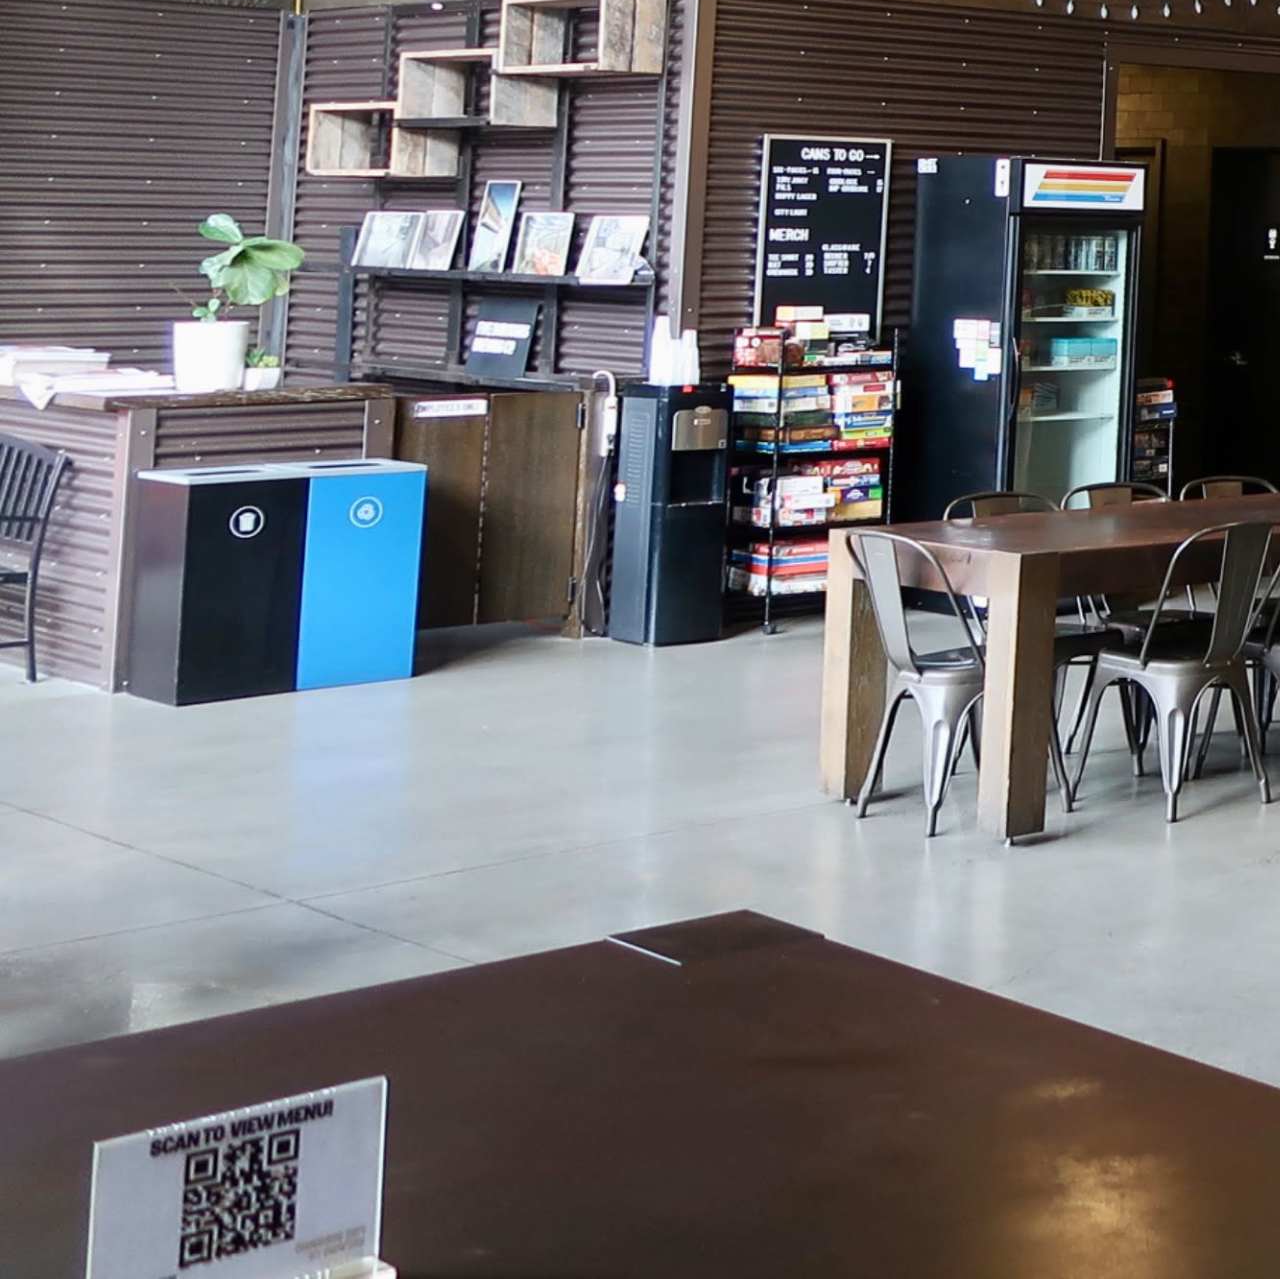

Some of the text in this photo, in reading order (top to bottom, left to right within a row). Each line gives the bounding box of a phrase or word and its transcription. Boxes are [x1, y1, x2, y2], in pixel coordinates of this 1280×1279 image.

[801, 147, 865, 162] CANS TO GO
[769, 228, 809, 241] MERCH
[151, 1100, 334, 1157] SCAN TO VIEW MENU!
